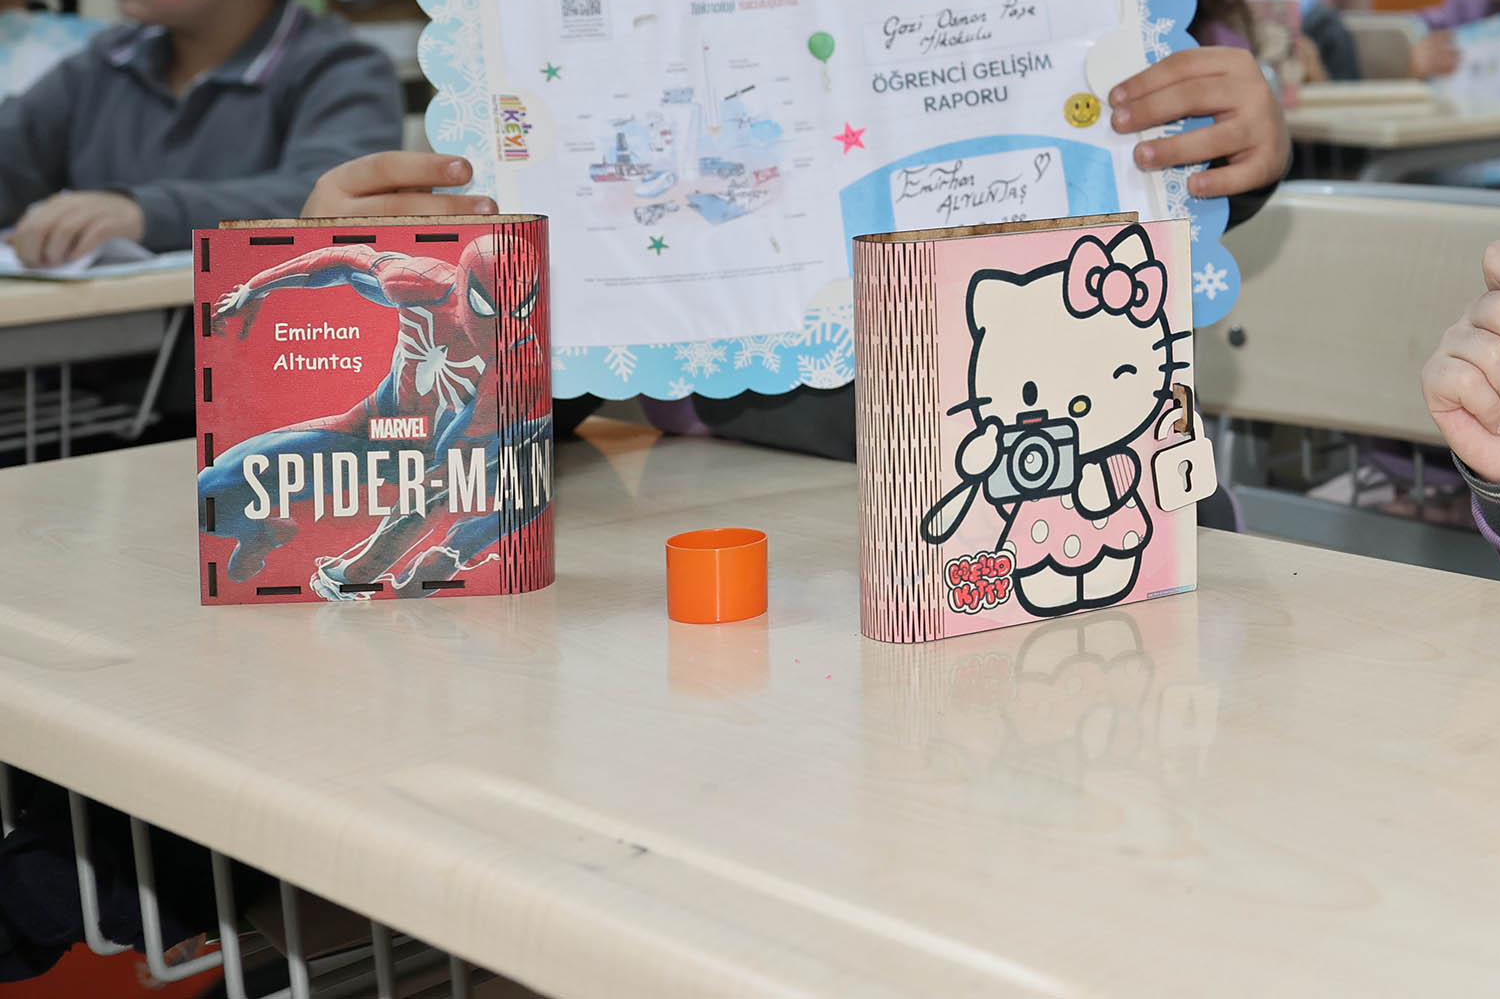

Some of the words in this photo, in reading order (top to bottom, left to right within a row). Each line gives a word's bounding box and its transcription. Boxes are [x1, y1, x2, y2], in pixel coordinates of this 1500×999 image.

[871, 61, 967, 95] ÖĞRENCİ
[972, 51, 1054, 80] GELİŞİM
[923, 85, 1009, 113] RAPORU
[503, 110, 524, 147] KEY
[274, 322, 360, 342] Emirhan
[273, 353, 363, 373] Altuntaş
[370, 417, 427, 439] MARVEL
[242, 447, 554, 523] SPIDER-MAN
[949, 554, 1012, 586] HELLO
